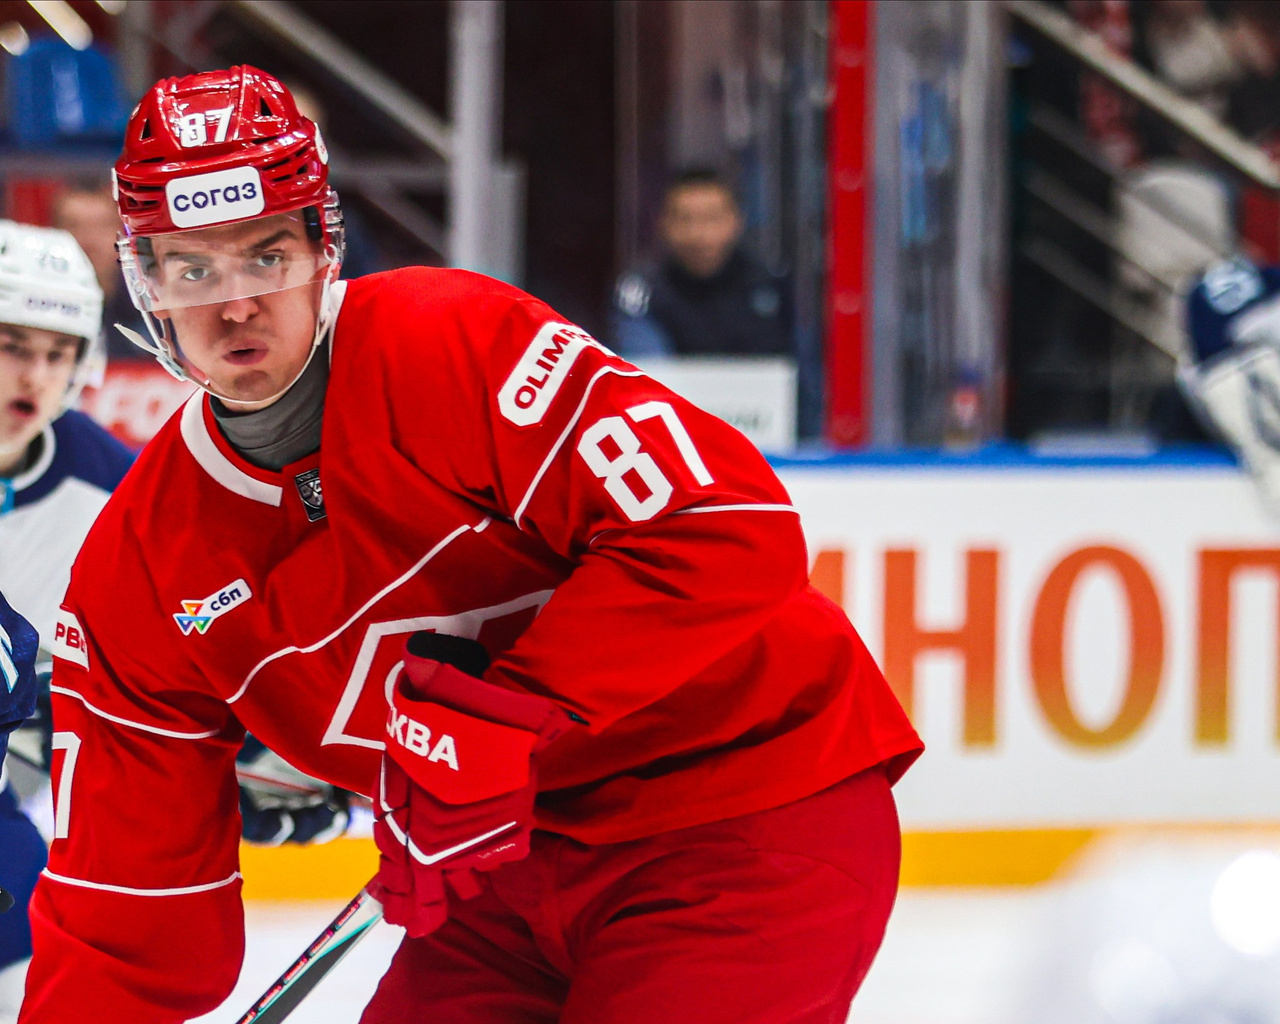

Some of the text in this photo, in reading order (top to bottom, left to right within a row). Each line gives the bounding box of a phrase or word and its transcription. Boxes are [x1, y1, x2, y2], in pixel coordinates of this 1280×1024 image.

[180, 105, 235, 147] 87
[577, 401, 715, 522] 87
[52, 731, 82, 839] 7
